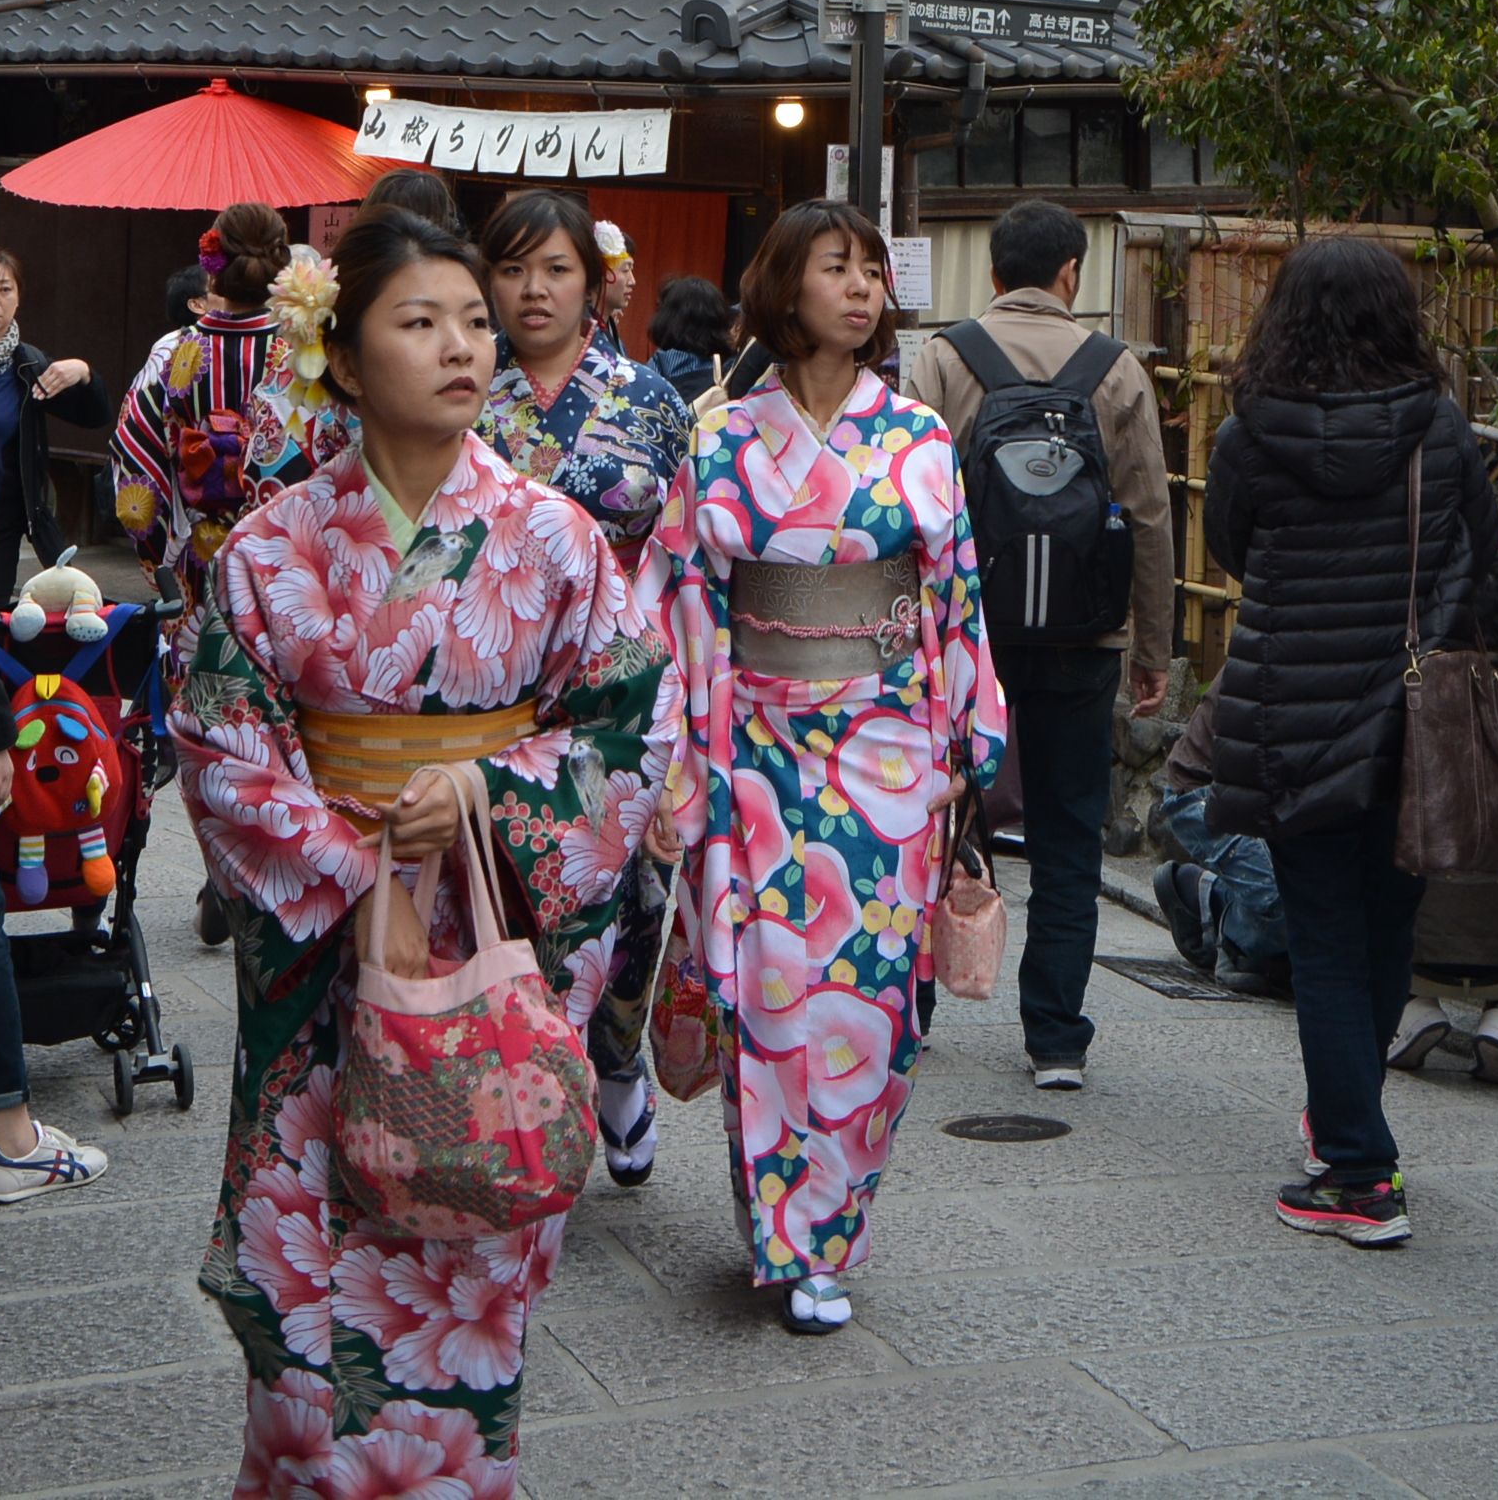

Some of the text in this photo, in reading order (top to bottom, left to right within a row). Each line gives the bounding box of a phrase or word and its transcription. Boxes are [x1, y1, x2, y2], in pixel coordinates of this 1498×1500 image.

[921, 20, 970, 31] Yasaka Pagoda
[1029, 13, 1071, 31] 高台寺
[364, 108, 609, 162] 山椒ちりめん
